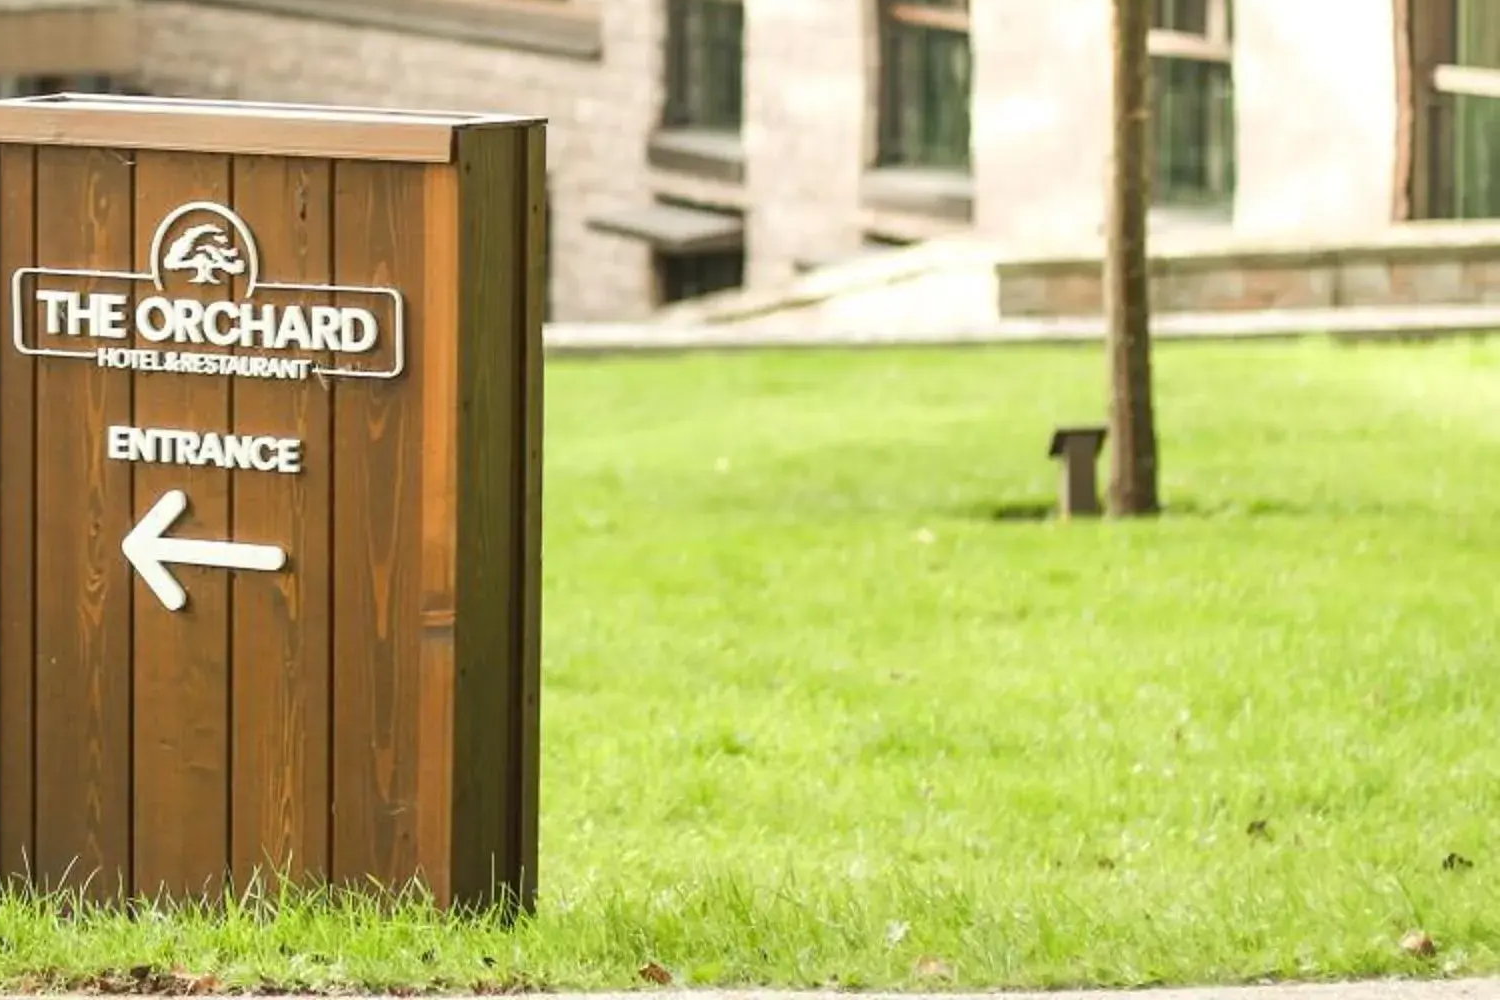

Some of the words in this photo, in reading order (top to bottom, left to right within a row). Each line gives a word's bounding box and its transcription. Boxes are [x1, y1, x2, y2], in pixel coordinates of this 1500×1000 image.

[36, 289, 128, 340] THE
[135, 296, 379, 353] ORCHARD
[107, 425, 301, 473] ENTRANCE
